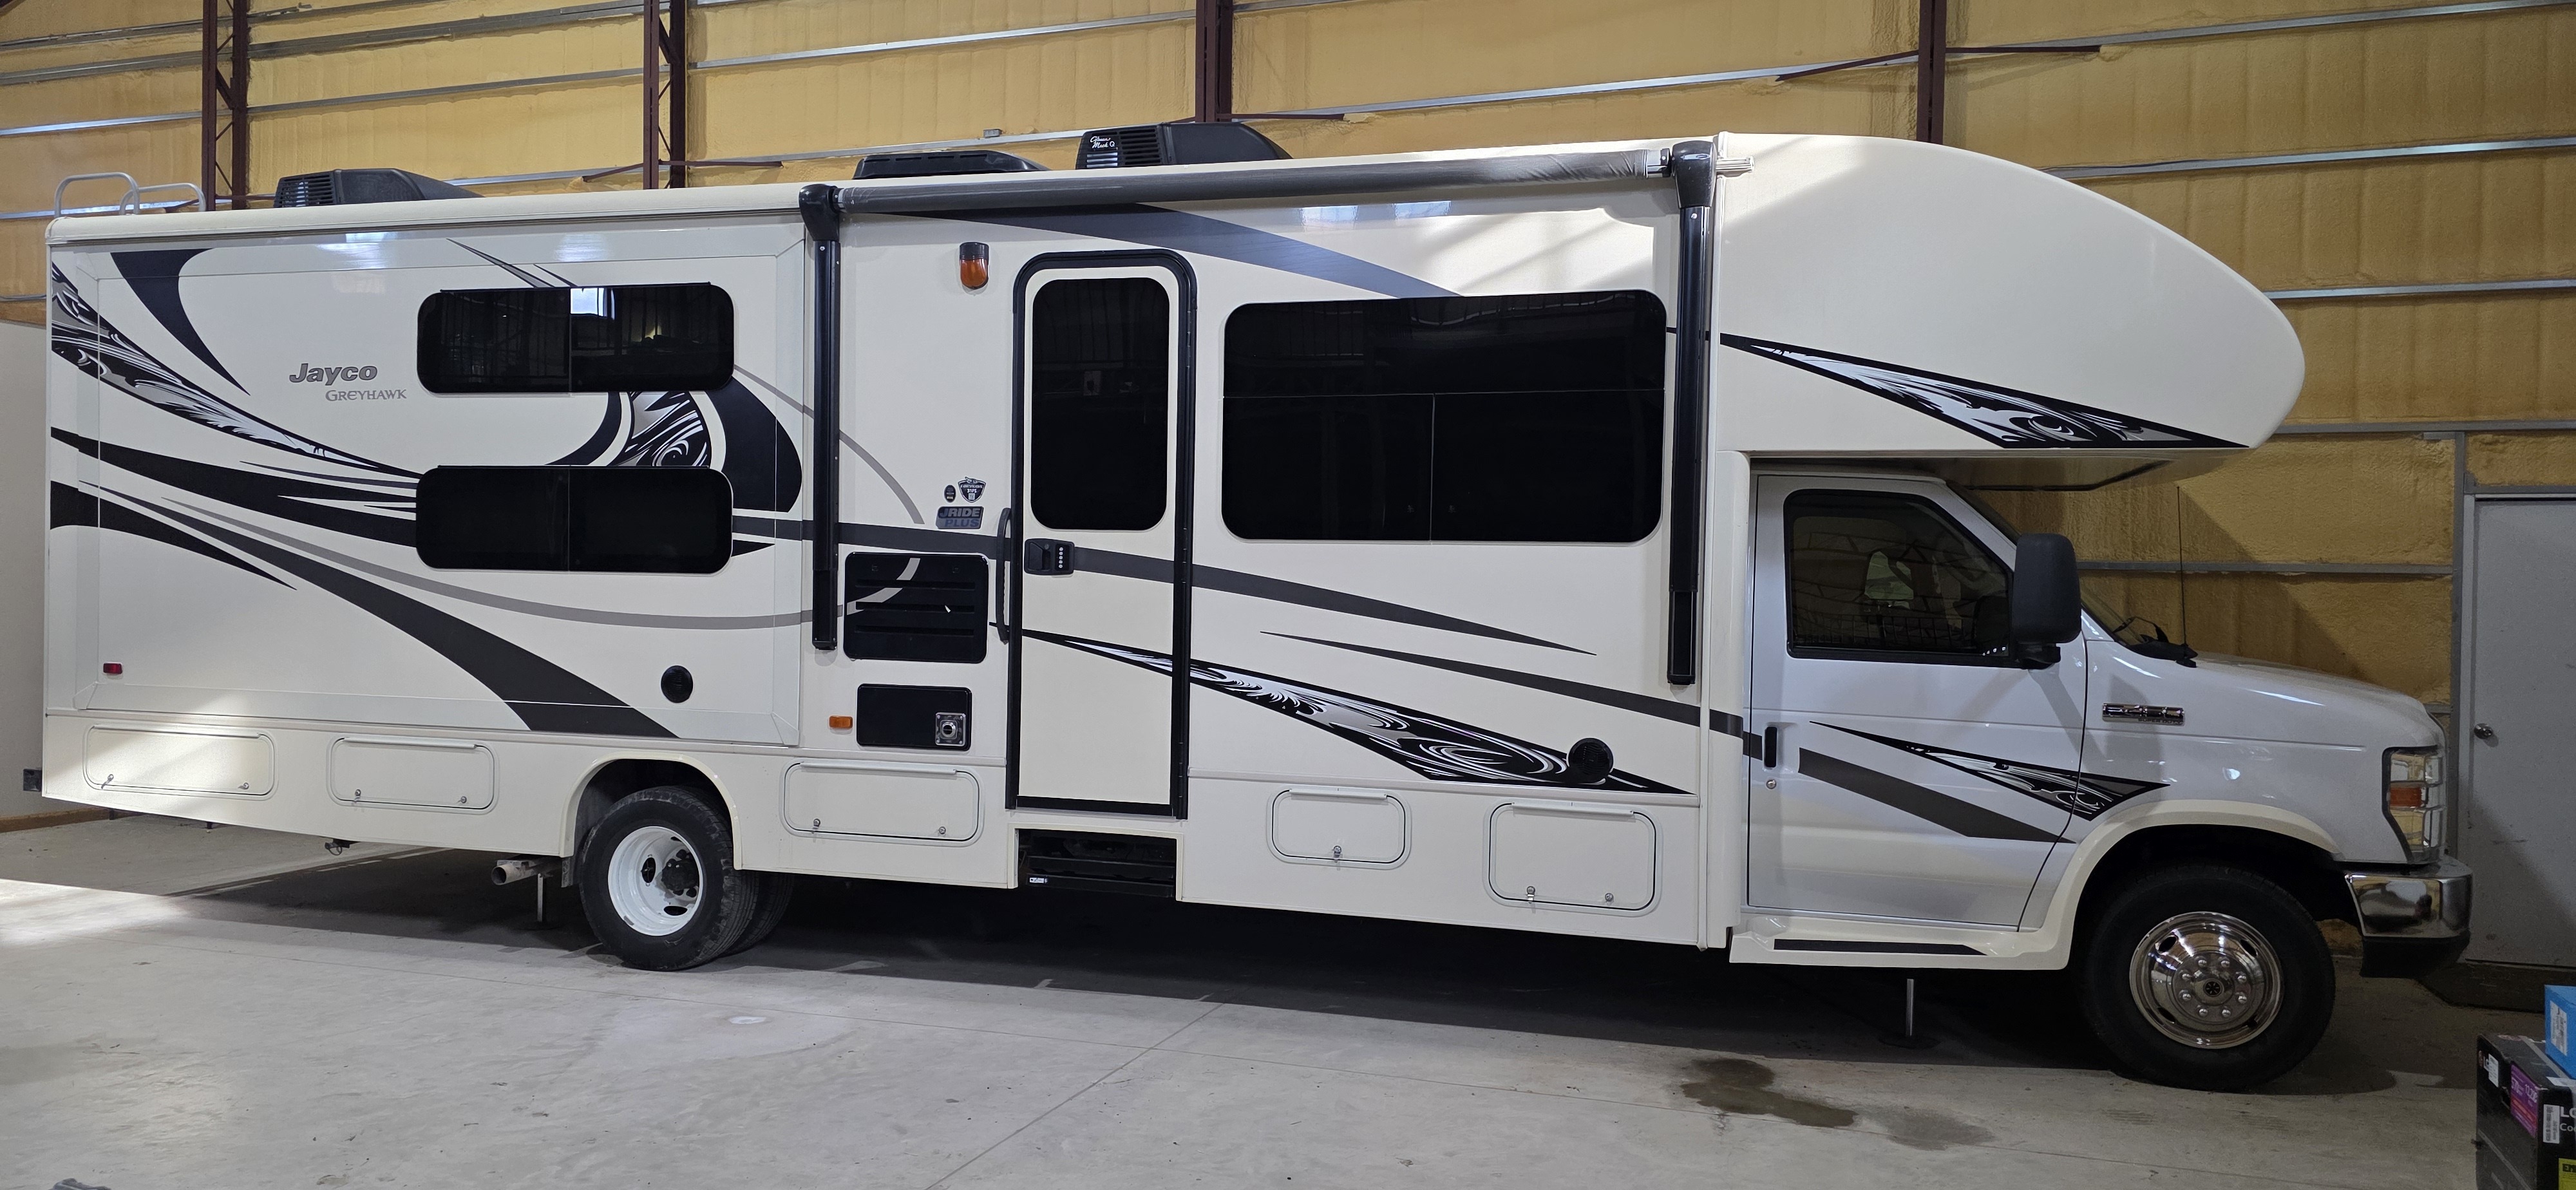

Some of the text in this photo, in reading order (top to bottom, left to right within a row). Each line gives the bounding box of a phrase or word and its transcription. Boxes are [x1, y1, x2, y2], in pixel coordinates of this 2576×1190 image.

[289, 363, 378, 386] Jayco
[325, 389, 407, 401] GREYHAWK
[940, 508, 980, 517] JRIDE
